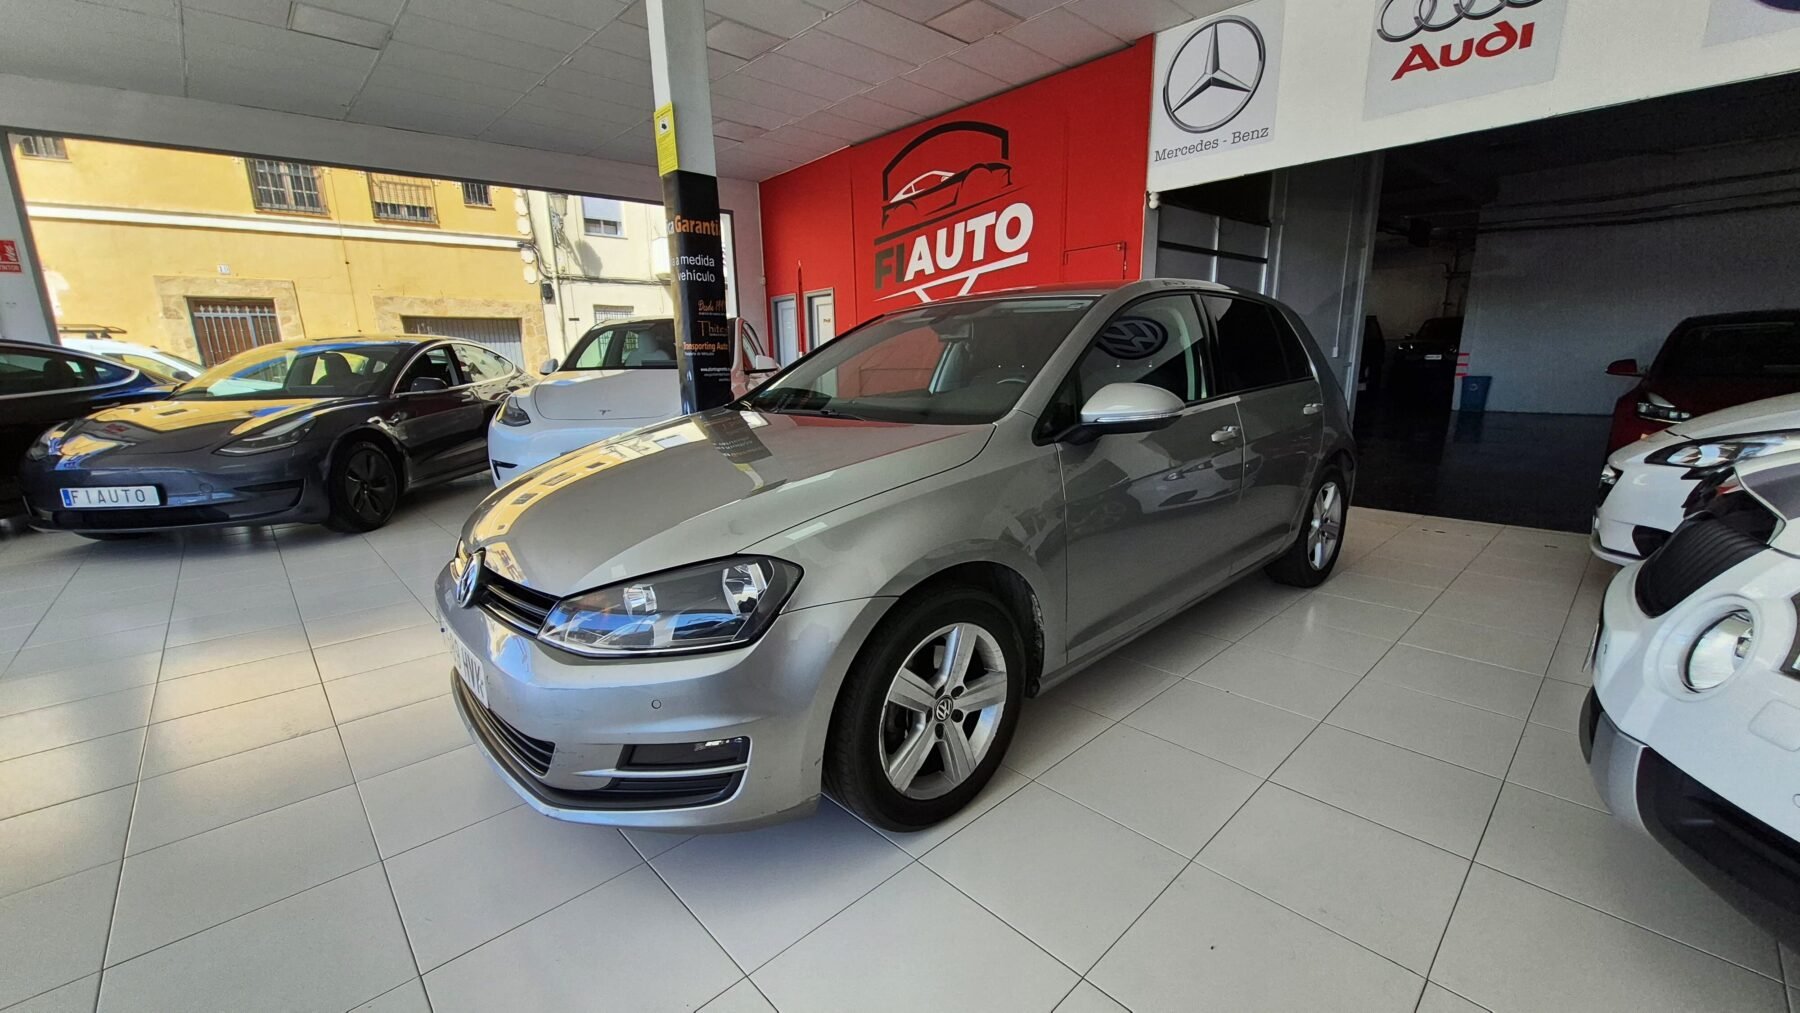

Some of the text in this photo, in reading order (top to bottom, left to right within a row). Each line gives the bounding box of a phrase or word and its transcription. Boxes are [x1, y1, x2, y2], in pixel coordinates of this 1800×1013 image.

[1391, 20, 1535, 81] Audi
[1154, 139, 1219, 162] Mercedes
[1231, 127, 1269, 145] Benz
[874, 202, 1034, 290] FIAUTO
[680, 254, 715, 267] medida
[677, 269, 716, 283] vehículo
[70, 489, 146, 504] FIAUTO
